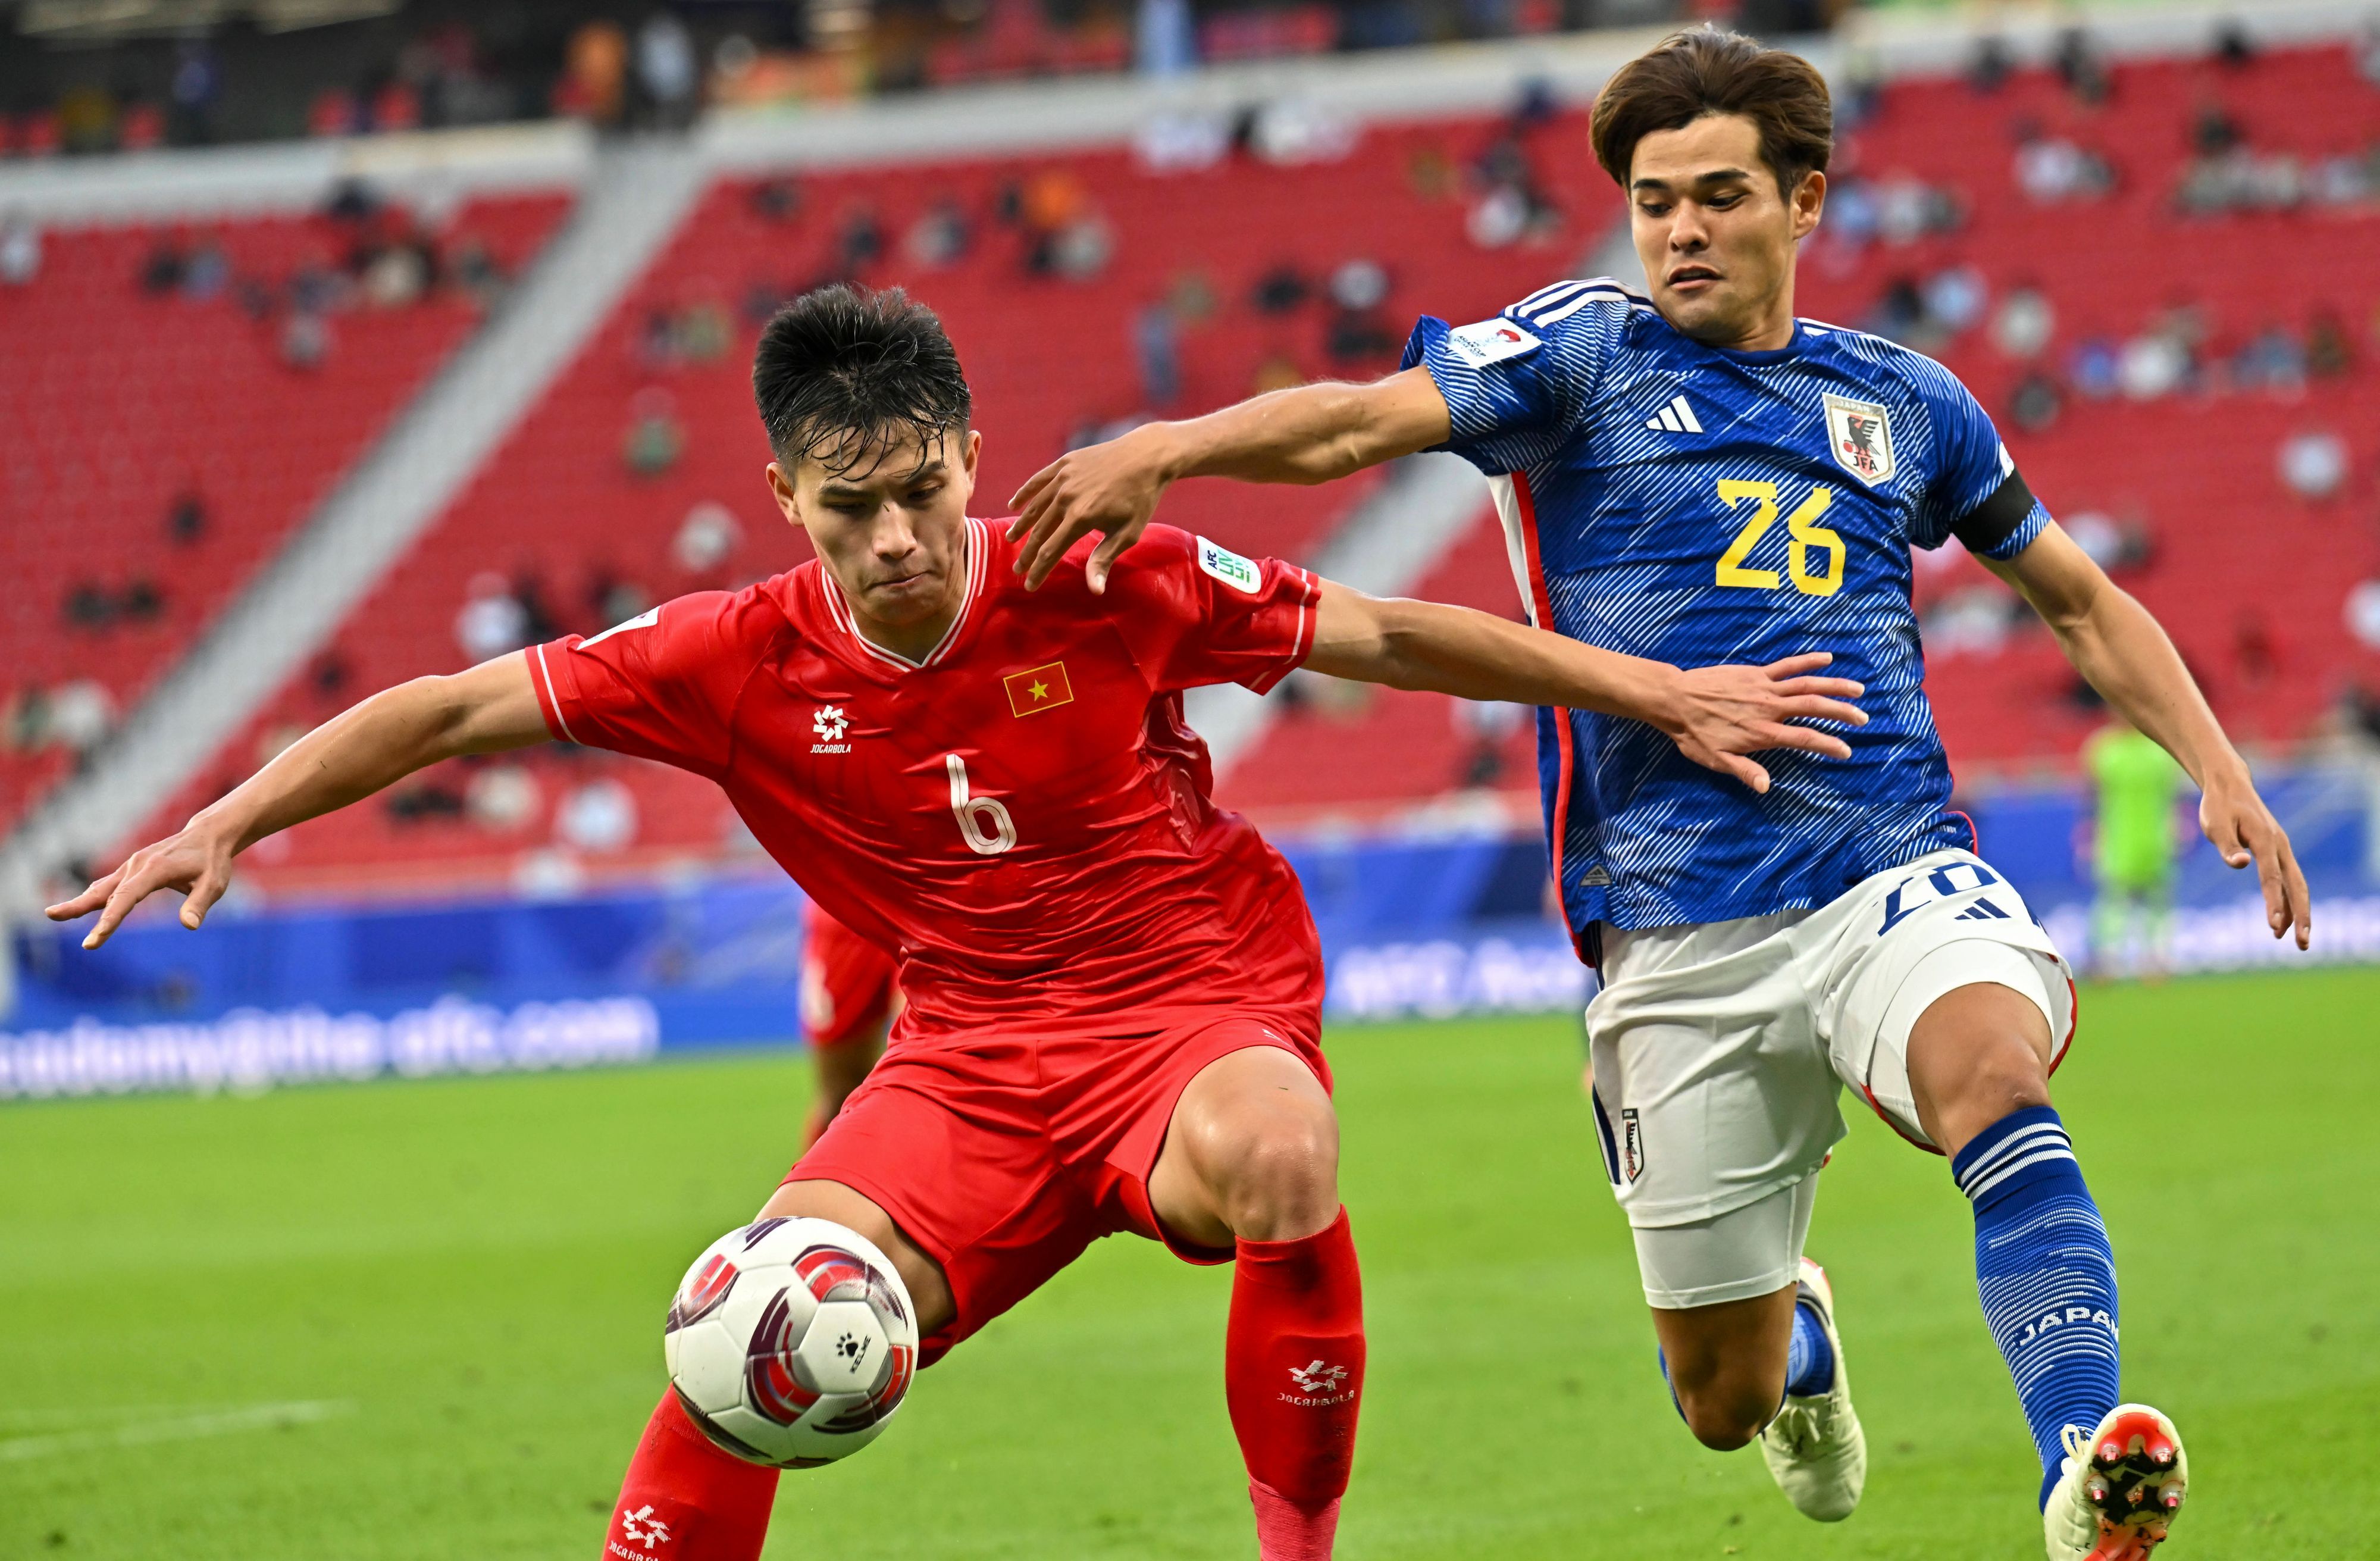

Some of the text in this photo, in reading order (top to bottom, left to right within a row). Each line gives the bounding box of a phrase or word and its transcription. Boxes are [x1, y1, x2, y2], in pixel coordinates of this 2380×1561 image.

[1853, 455, 1878, 472] JFA
[1715, 478, 1846, 597] 26
[1207, 550, 1217, 570] AFC
[810, 743, 851, 754] JOGARBOLA
[946, 753, 1017, 855] 6
[2019, 1307, 2119, 1346] JAPAN
[1277, 1390, 1355, 1406] JOGARBOLA
